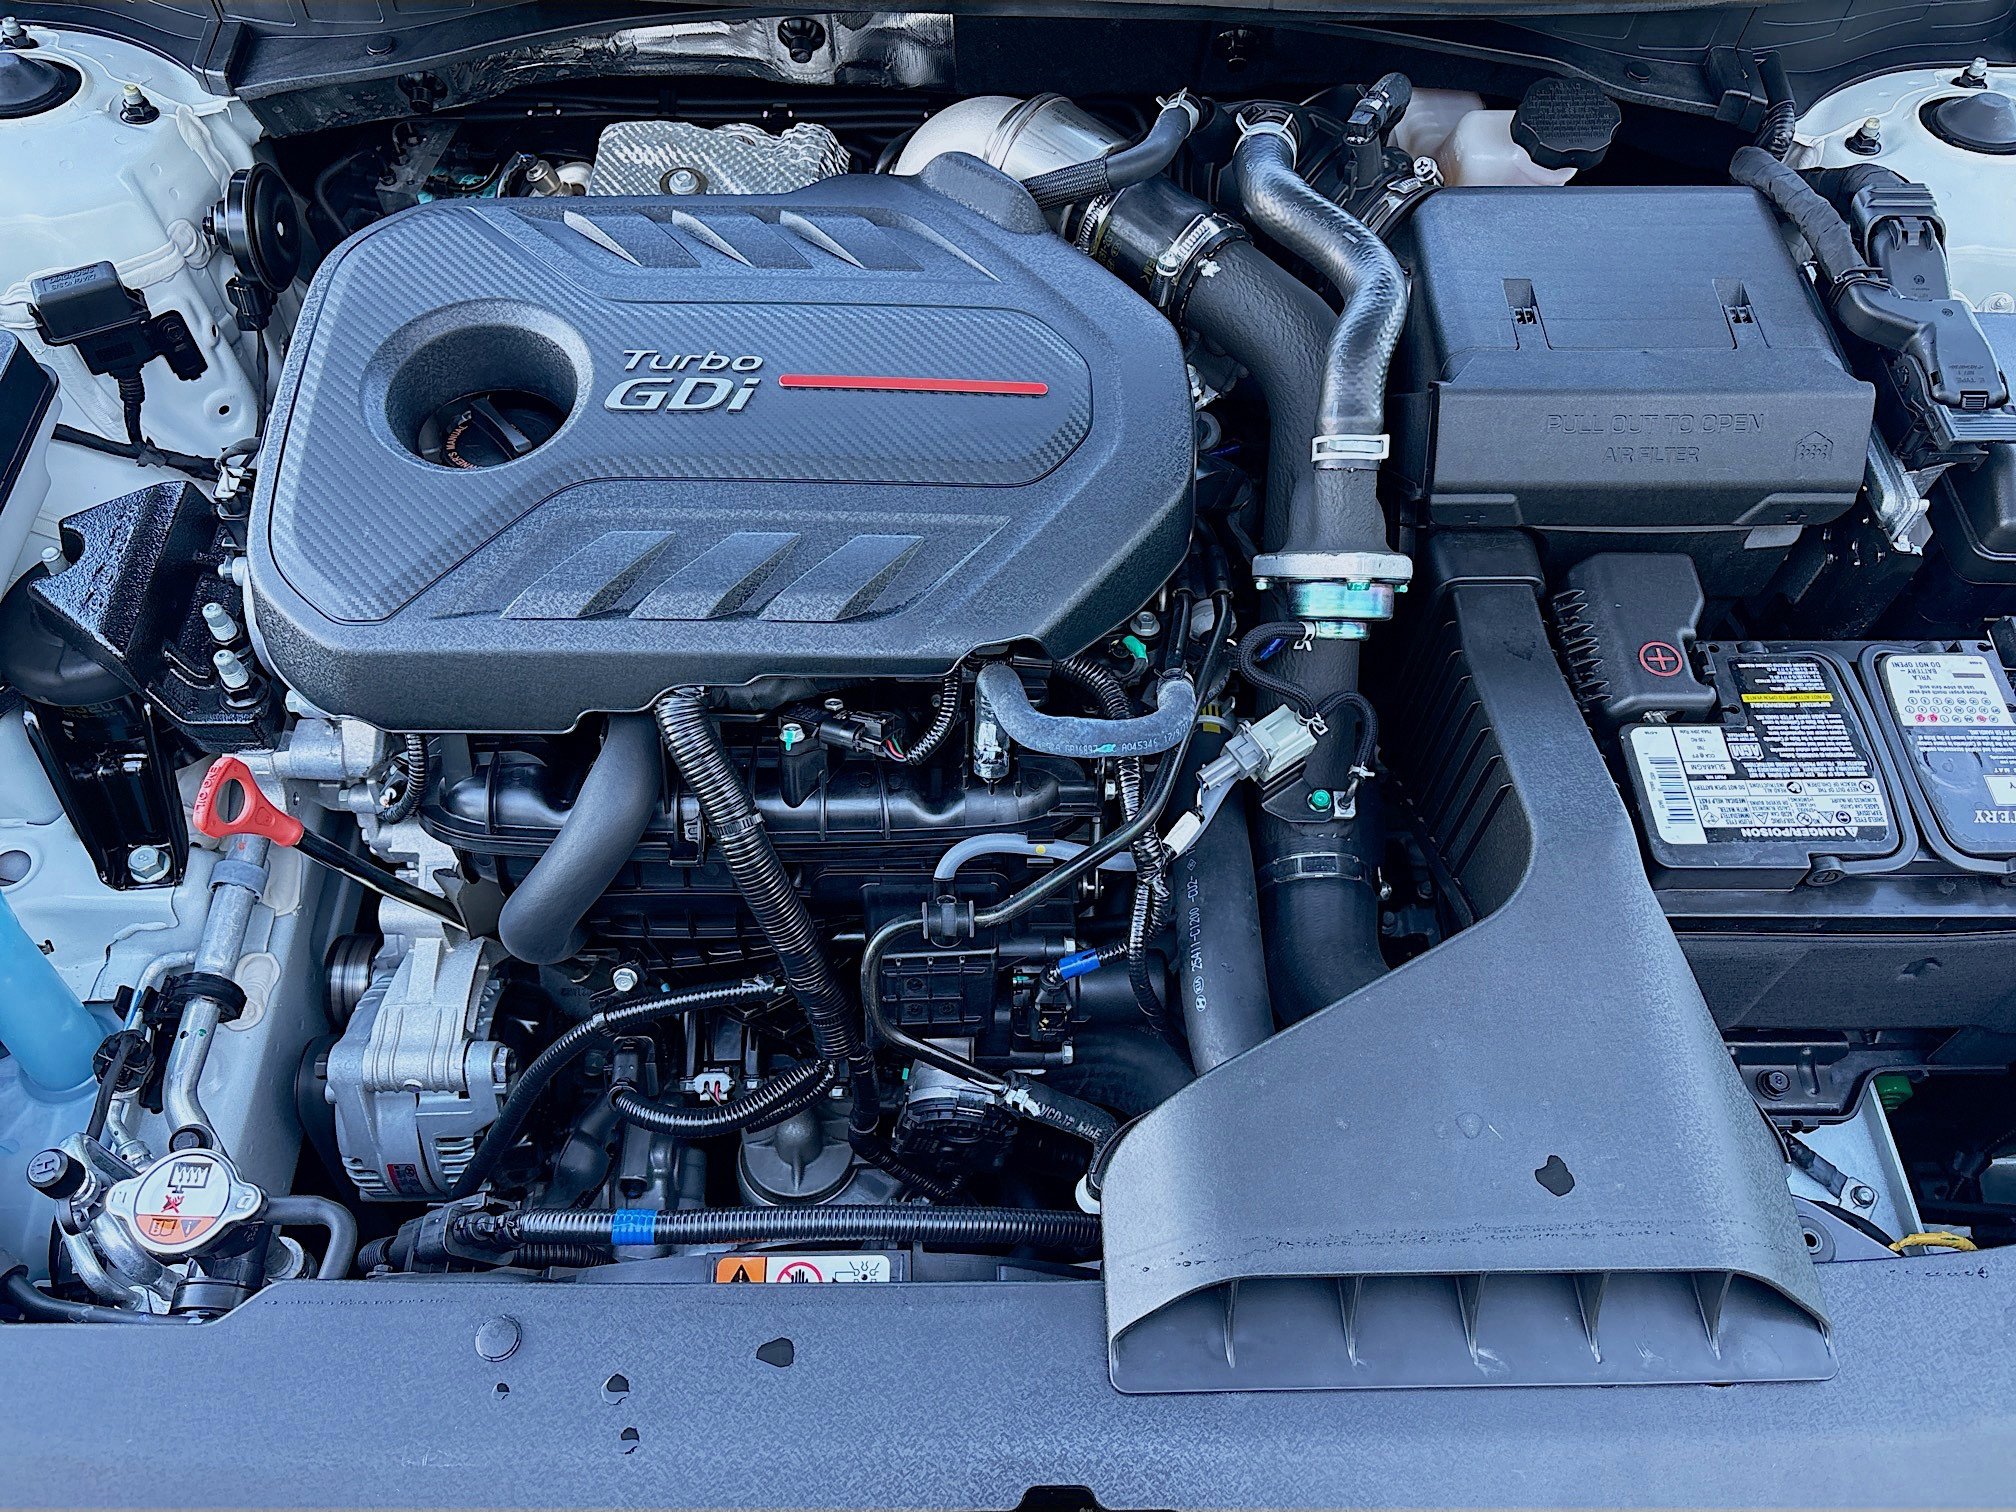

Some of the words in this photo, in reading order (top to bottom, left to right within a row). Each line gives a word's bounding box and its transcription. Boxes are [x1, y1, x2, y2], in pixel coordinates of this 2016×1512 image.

[623, 350, 763, 371] Turbo
[604, 377, 761, 412] GDi
[1547, 413, 1604, 434] PULL
[1611, 413, 1658, 434] OUT
[1664, 413, 1694, 434] TO
[1701, 413, 1764, 434] OPEN
[446, 424, 469, 450] MANUAL
[1602, 446, 1633, 463] AIR
[1640, 446, 1700, 463] FILTER
[1731, 745, 1759, 757] AGM
[203, 766, 219, 789] ENG
[196, 792, 209, 811] OIL
[1741, 827, 1846, 837] DANGER/POISON
[1189, 906, 1203, 972] 25411-C1200
[1193, 975, 1205, 995] KIA
[36, 1159, 56, 1175] H
